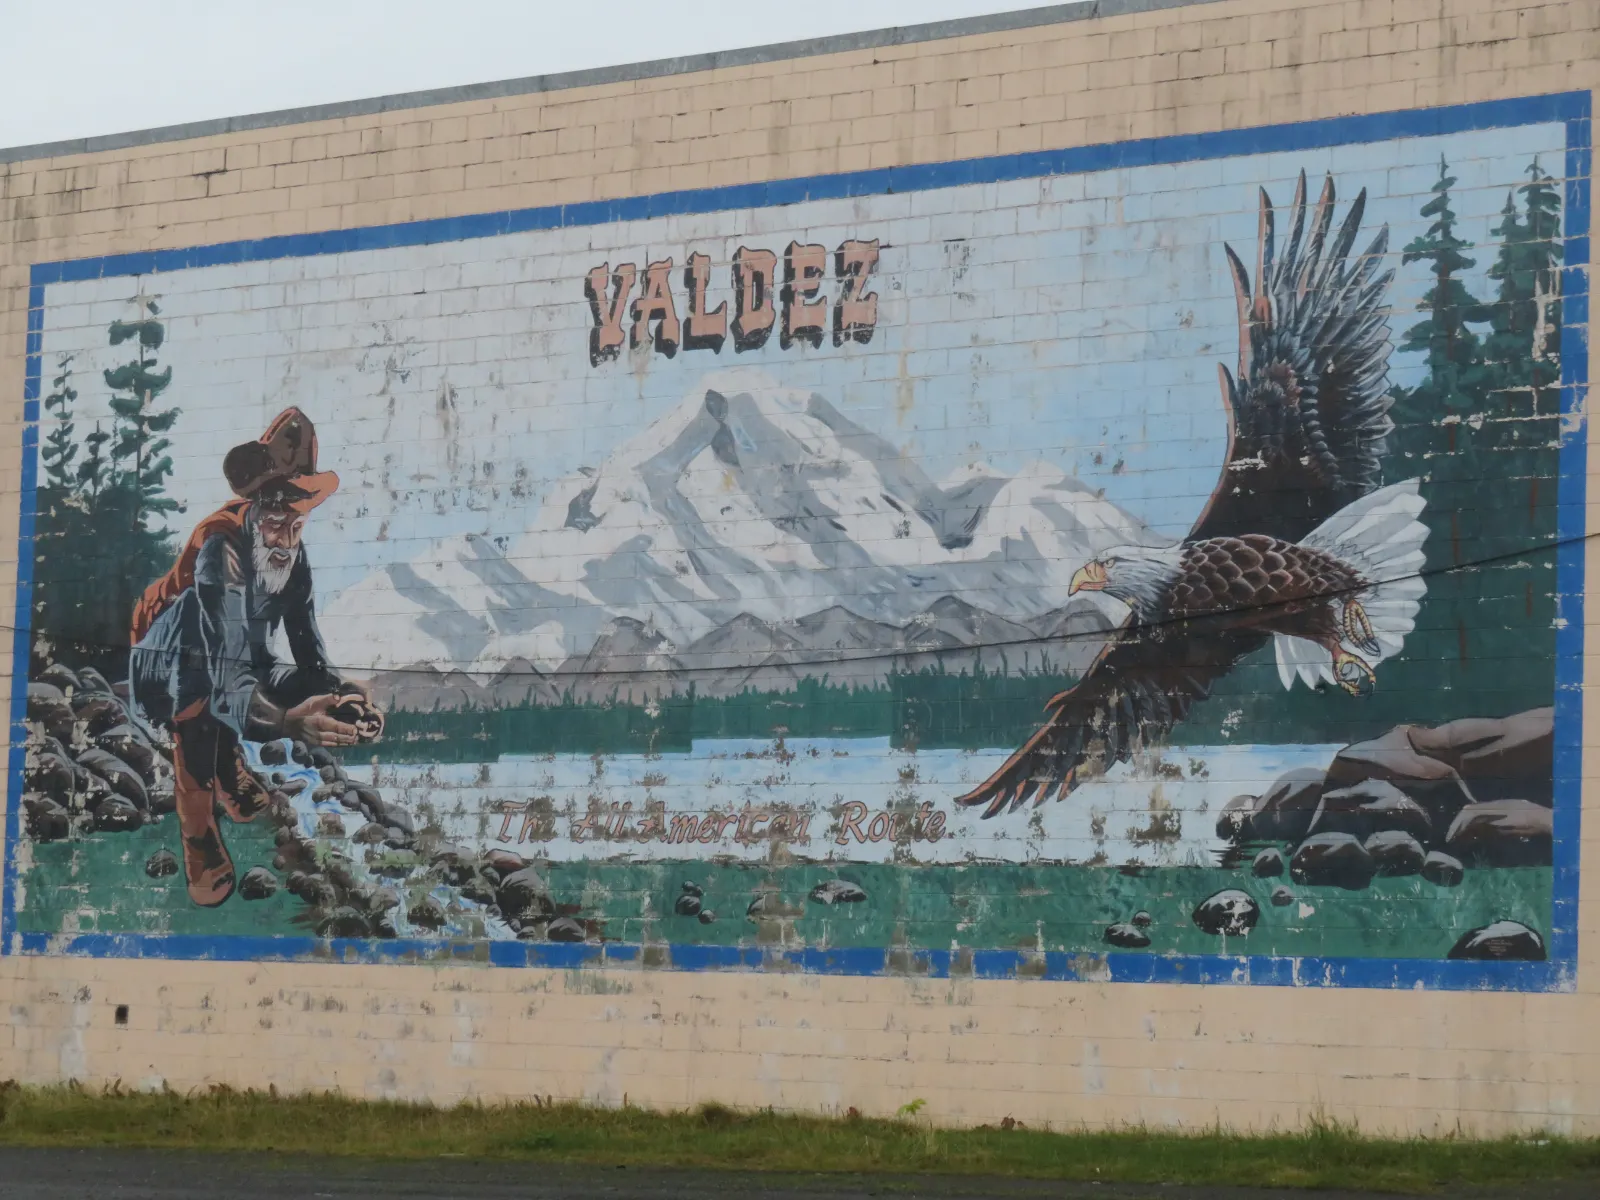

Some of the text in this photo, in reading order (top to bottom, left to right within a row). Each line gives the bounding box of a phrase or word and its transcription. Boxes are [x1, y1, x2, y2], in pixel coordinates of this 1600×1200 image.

[585, 237, 880, 368] VALDEZ
[570, 800, 633, 845] All
[636, 799, 813, 848] American
[835, 800, 947, 845] Route
